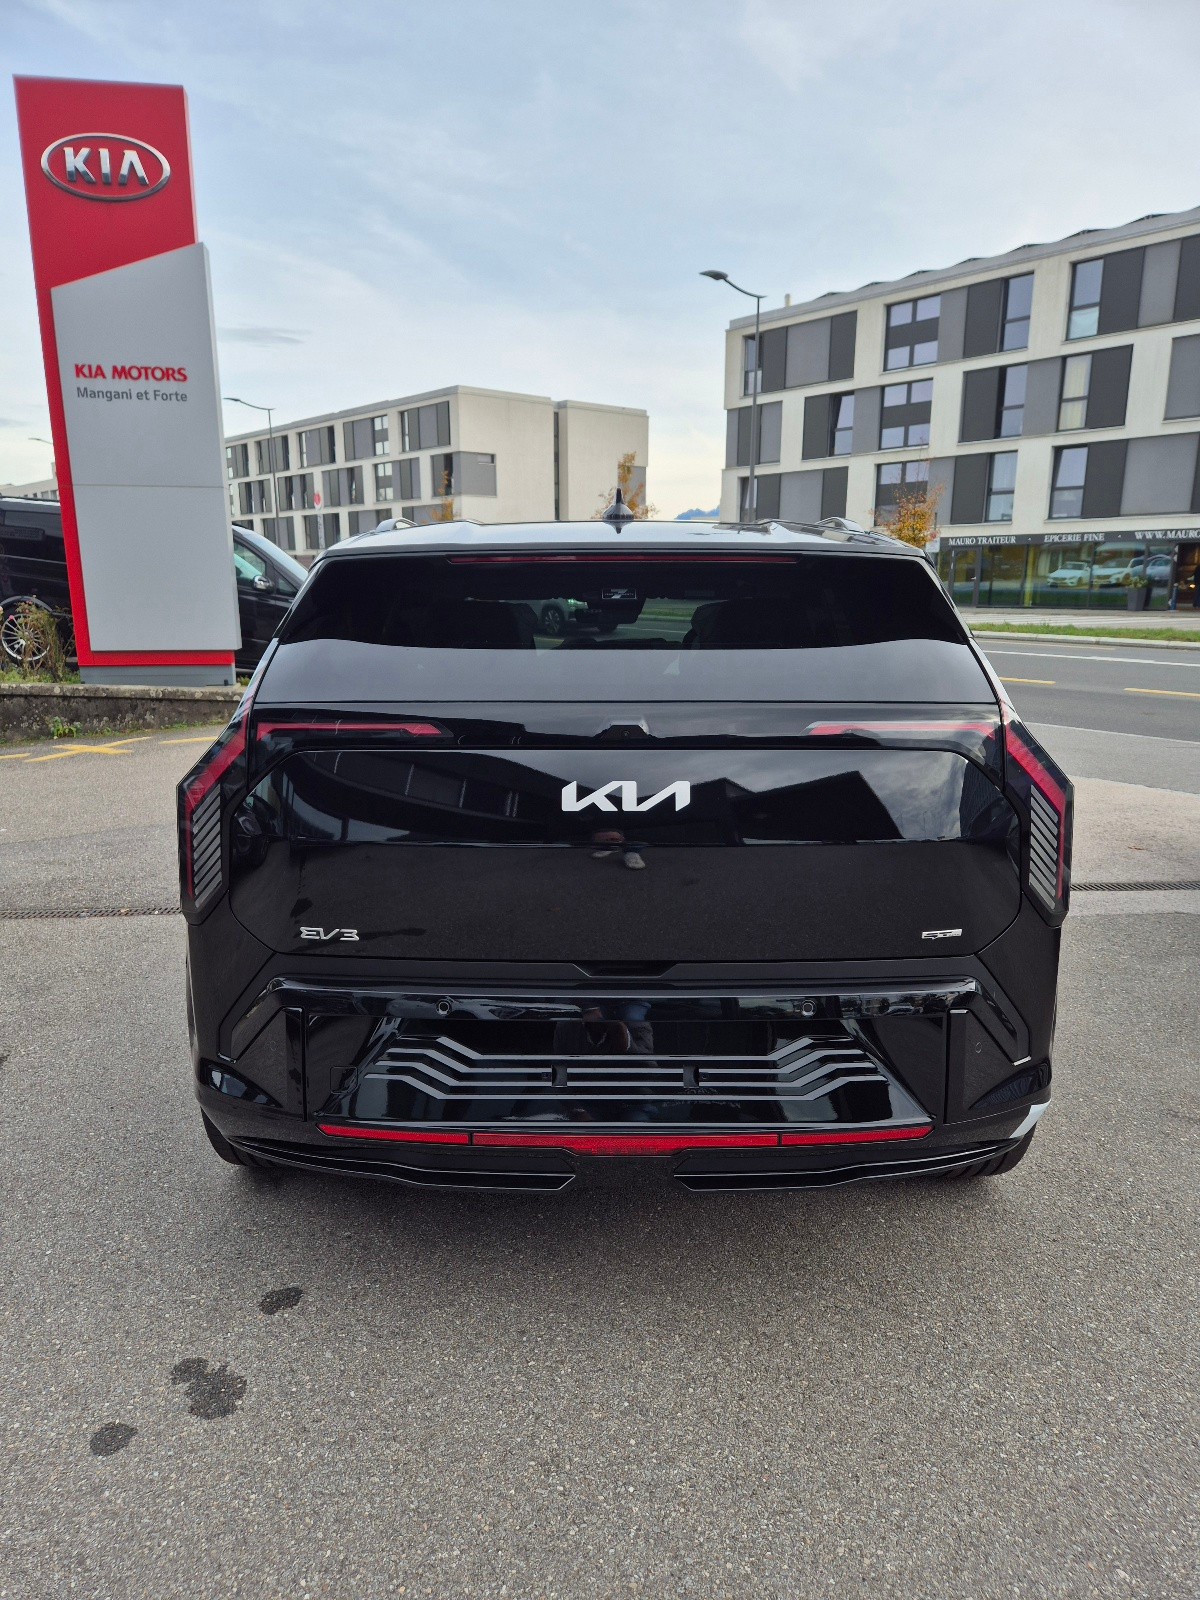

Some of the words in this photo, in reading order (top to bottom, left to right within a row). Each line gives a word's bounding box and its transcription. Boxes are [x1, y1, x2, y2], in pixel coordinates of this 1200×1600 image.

[63, 147, 149, 185] KIA
[74, 364, 106, 379] KIA
[112, 365, 188, 382] MOTORS
[76, 387, 132, 401] Mangani
[136, 390, 150, 400] et
[153, 390, 188, 401] Forte
[949, 538, 976, 546] MAURO
[977, 536, 1017, 545] TRAITEUR
[1044, 534, 1081, 543] EPICERIE
[1083, 533, 1105, 541] FINE
[561, 780, 691, 812] KIA
[300, 926, 360, 941] EV3
